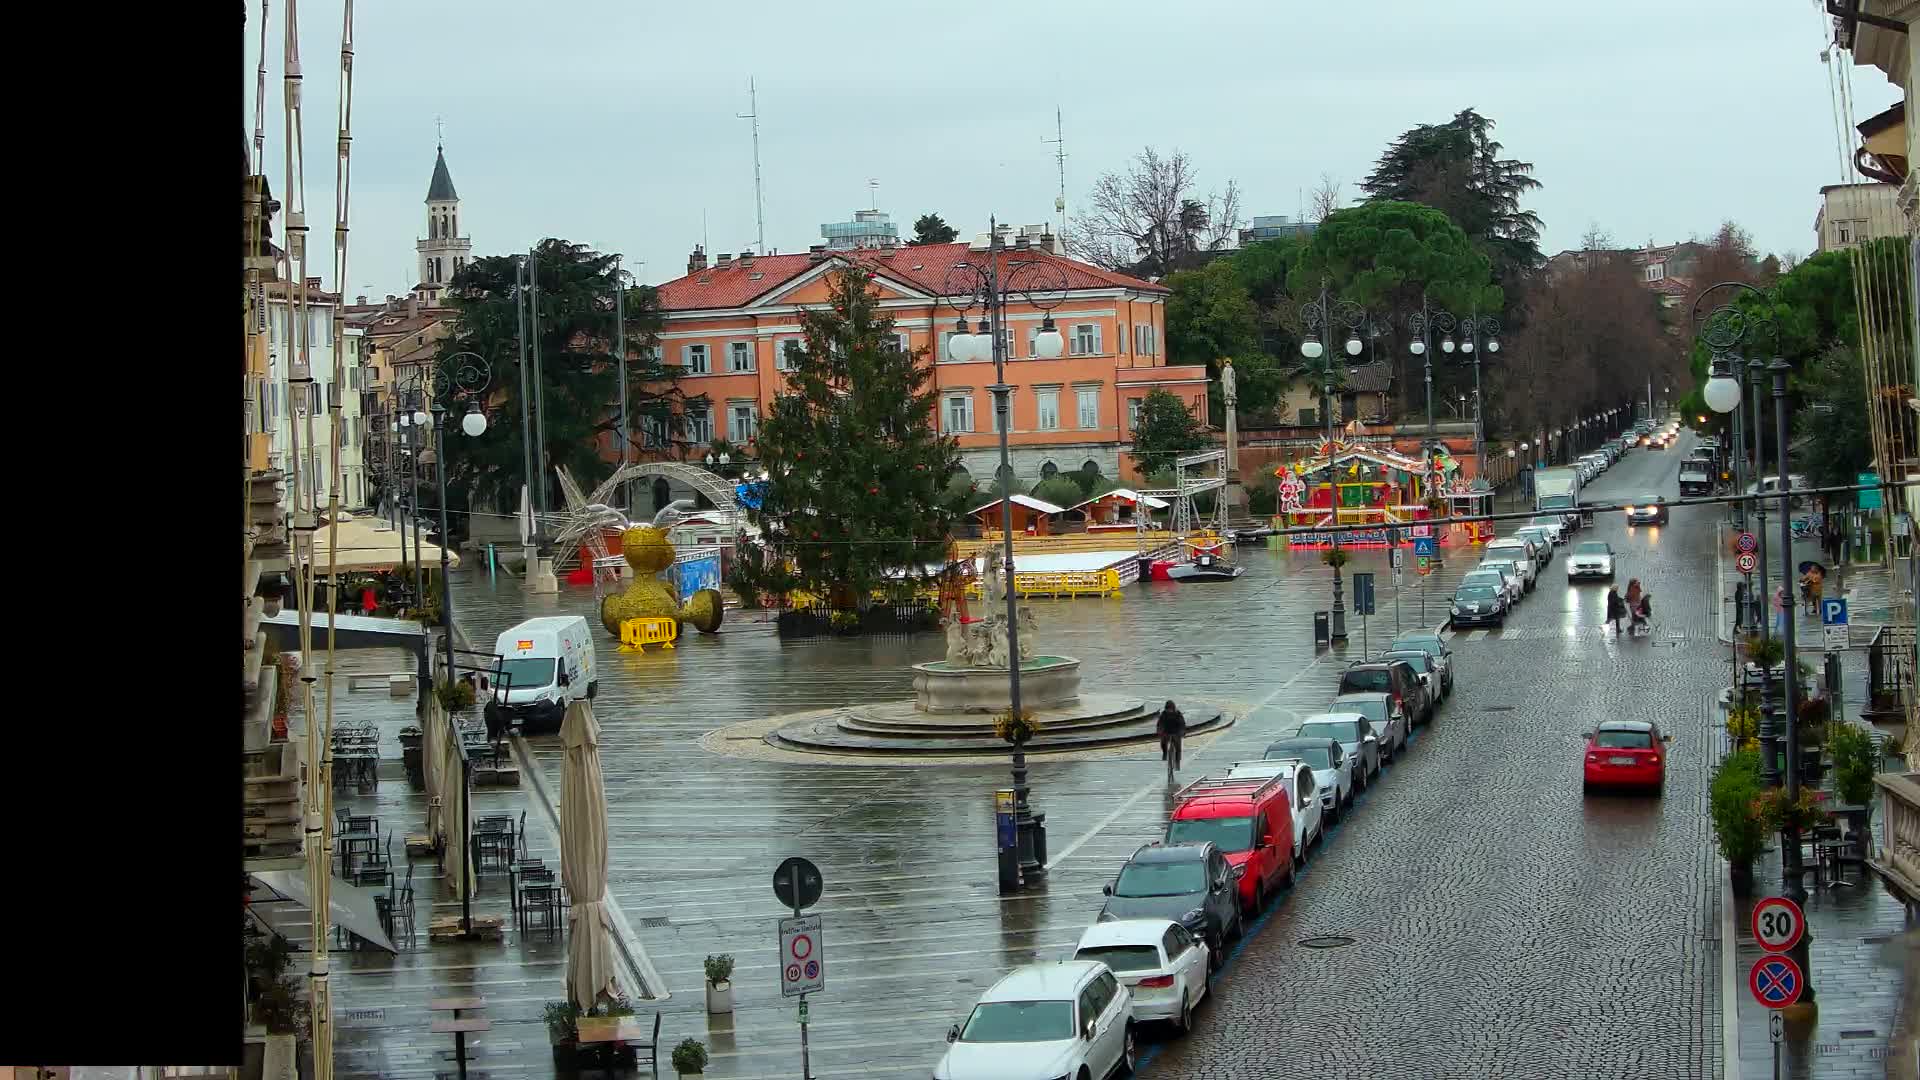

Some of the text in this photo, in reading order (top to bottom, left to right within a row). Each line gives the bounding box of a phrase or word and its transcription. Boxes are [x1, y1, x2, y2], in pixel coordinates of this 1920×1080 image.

[1742, 557, 1753, 567] 20
[1826, 602, 1842, 622] P
[1762, 911, 1792, 938] 30
